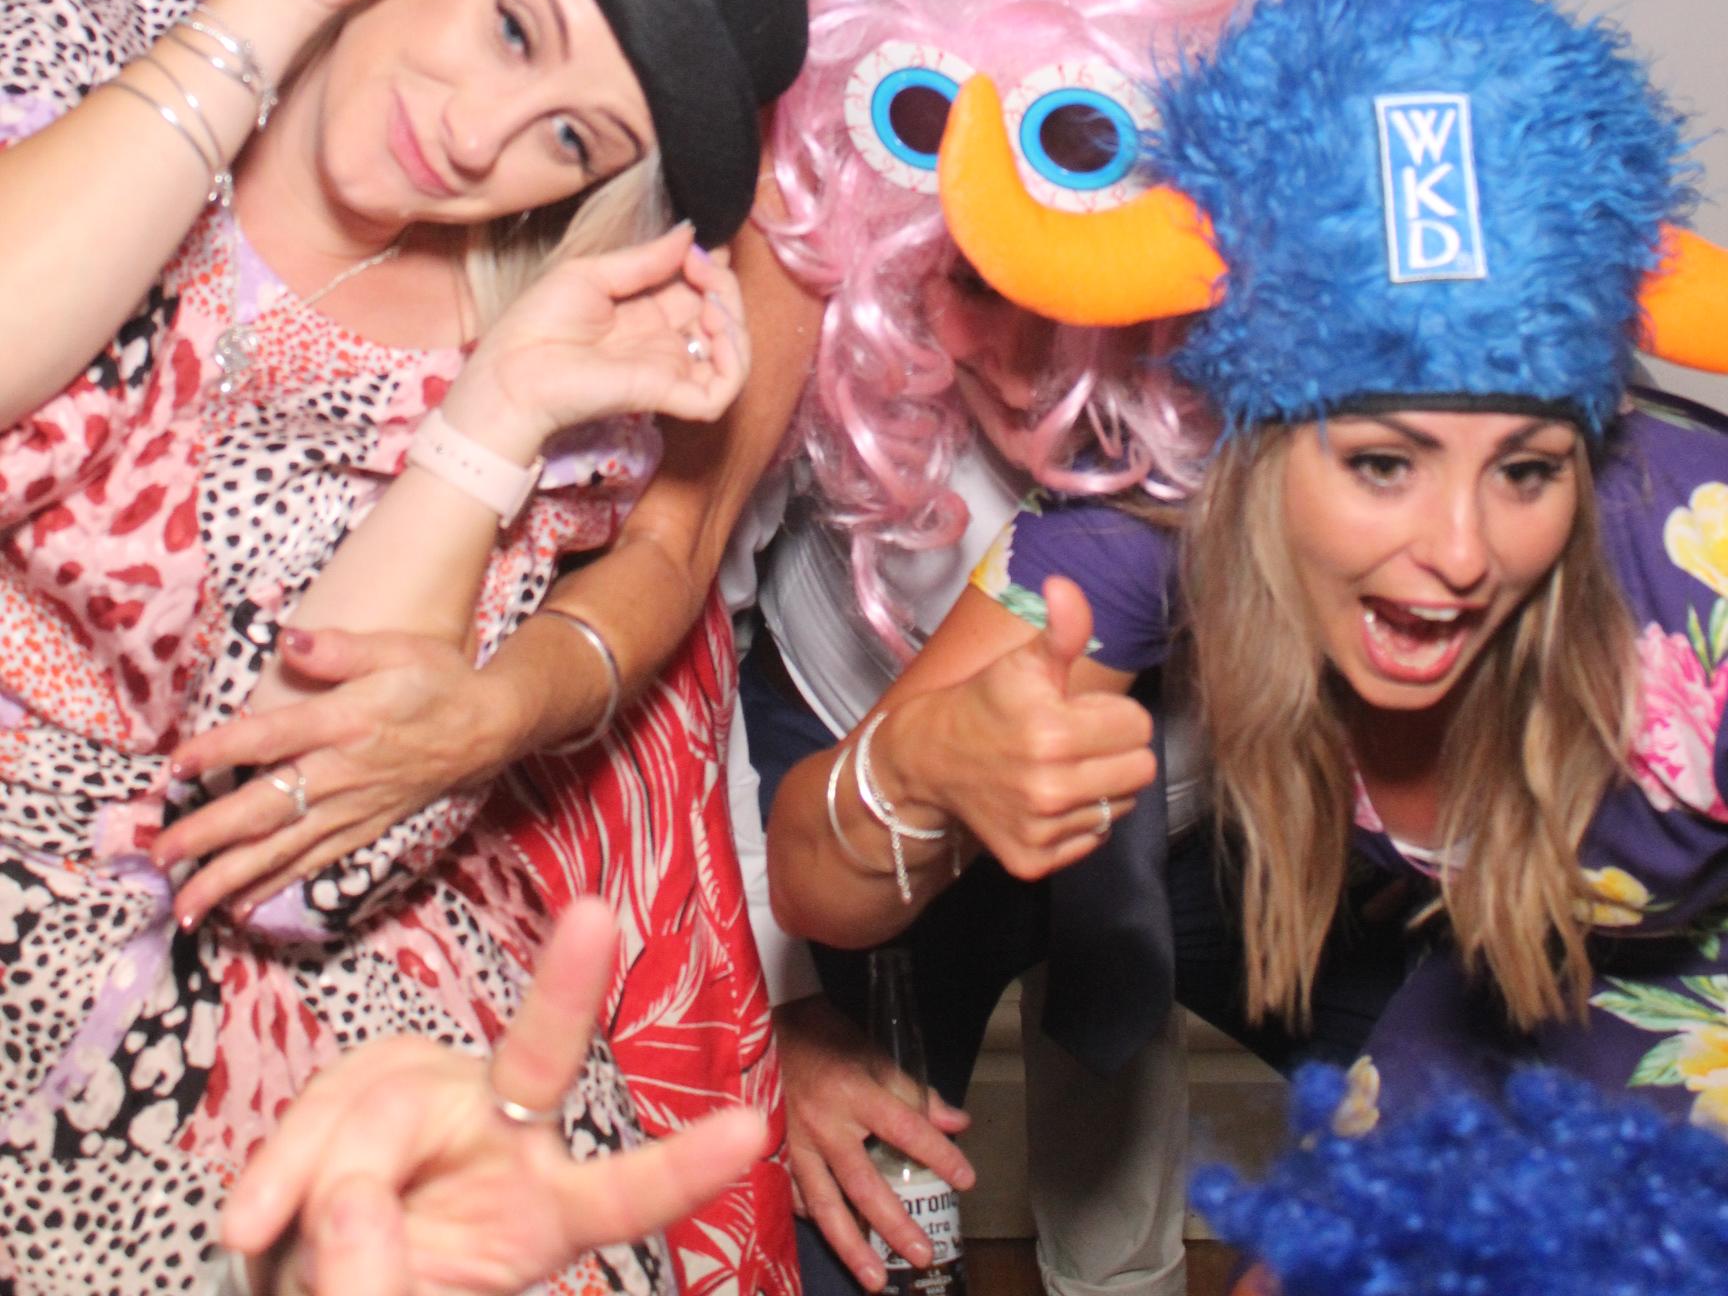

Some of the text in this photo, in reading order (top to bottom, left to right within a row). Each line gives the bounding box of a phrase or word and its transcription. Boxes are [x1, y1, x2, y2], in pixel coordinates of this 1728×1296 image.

[1389, 107, 1462, 270] WKD
[903, 1191, 957, 1216] oron
[928, 1220, 951, 1235] tra
